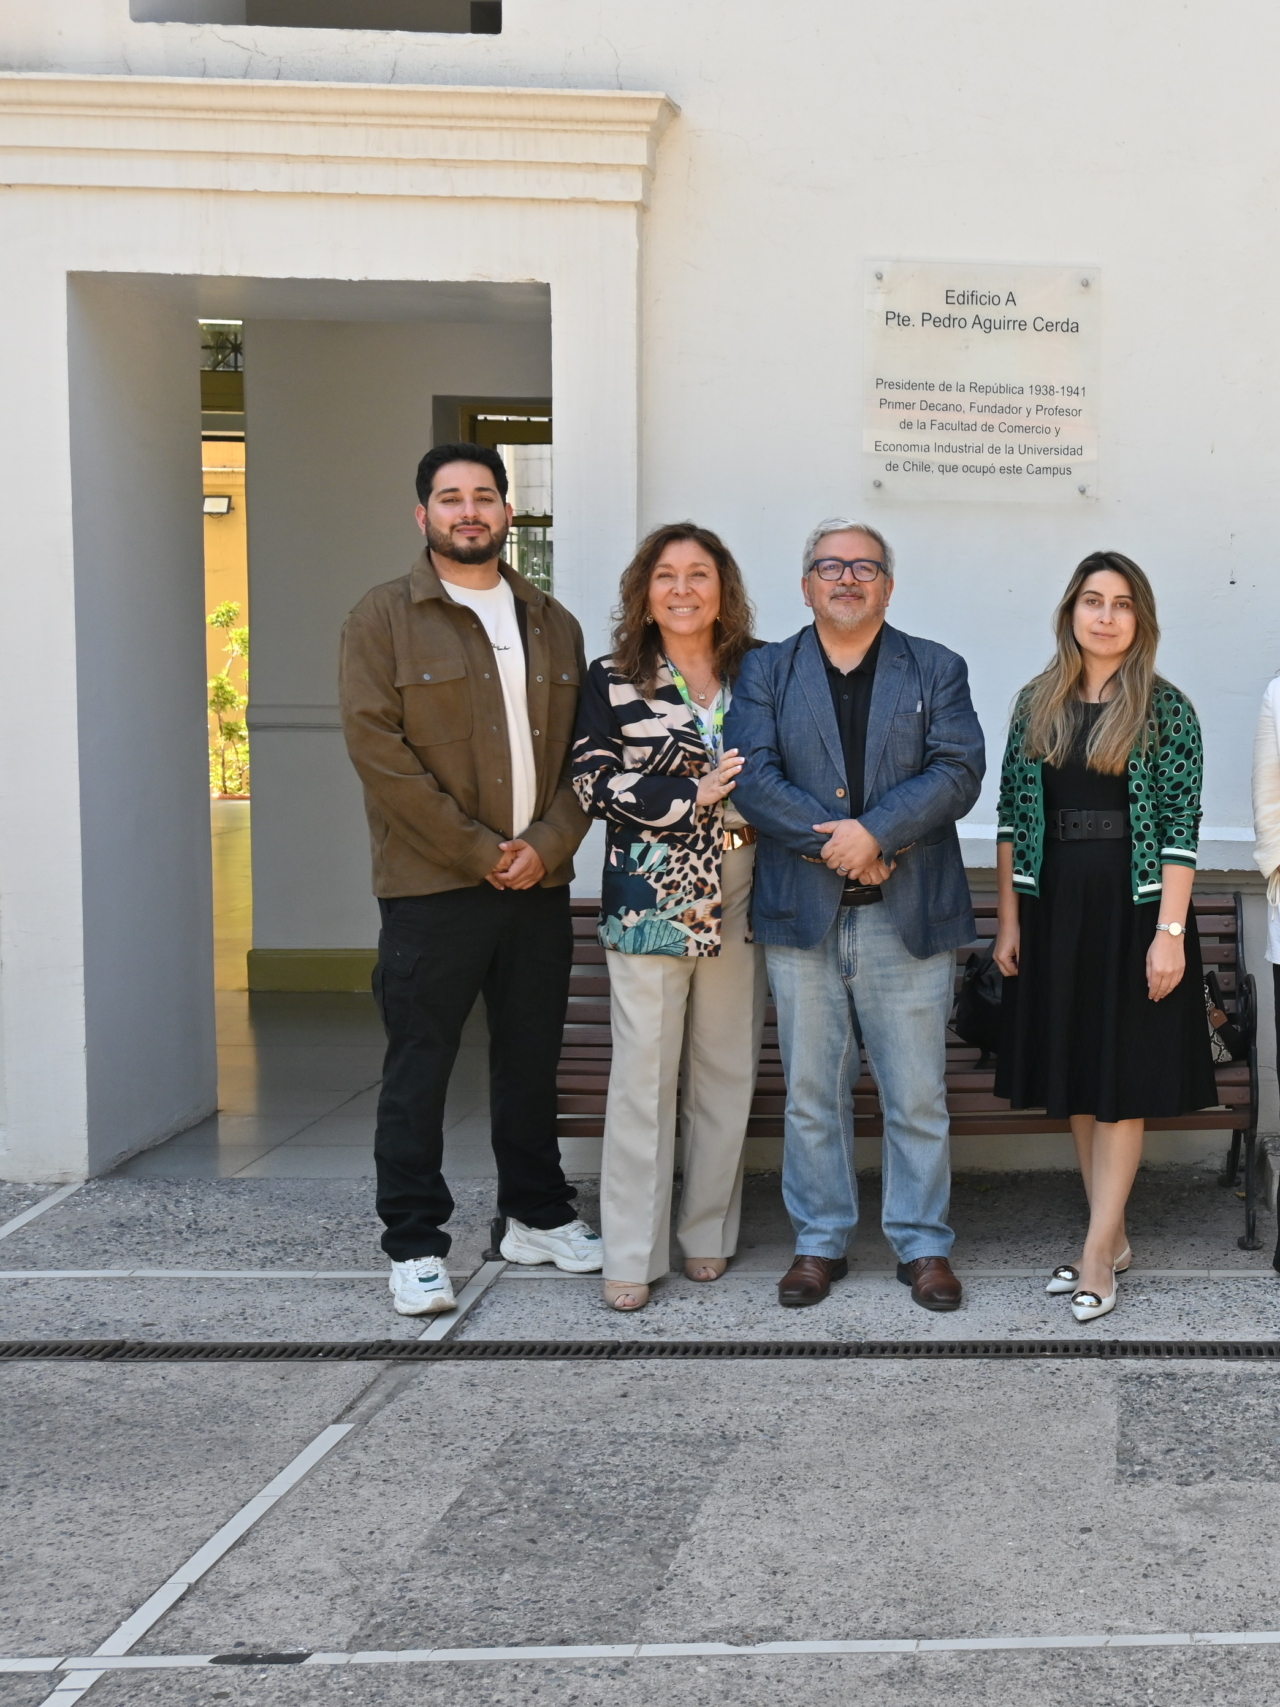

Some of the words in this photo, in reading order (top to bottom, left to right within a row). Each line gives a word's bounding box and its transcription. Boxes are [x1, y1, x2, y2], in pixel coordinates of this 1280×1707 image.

[945, 289, 1001, 307] Edificio
[1004, 290, 1017, 307] A
[885, 310, 915, 328] Pte.
[921, 311, 968, 330] Pedro
[970, 314, 1028, 334] Aguirre
[1032, 316, 1080, 334] Cerda
[875, 377, 936, 392] Presidente
[938, 380, 953, 393] de
[955, 381, 966, 393] la
[969, 381, 1025, 396] República
[1028, 384, 1086, 397] 1938-1941
[879, 397, 916, 411] Primer
[919, 399, 966, 414] Decano,
[969, 401, 1023, 415] Fundador
[1025, 406, 1032, 418] y
[1035, 404, 1083, 418] Profesor
[899, 418, 914, 430] de
[916, 419, 927, 431] la
[930, 419, 978, 432] Facultad
[980, 421, 995, 433] de
[998, 421, 1052, 435] Comercio
[1054, 426, 1061, 438] y
[934, 441, 985, 454] Industrial
[987, 443, 1002, 455] de
[1004, 443, 1015, 455] la
[1018, 443, 1083, 457] Universidad
[885, 460, 900, 472] de
[937, 464, 959, 476] que
[961, 461, 996, 477] ocupó
[998, 465, 1023, 475] este
[1025, 463, 1073, 478] Campus
